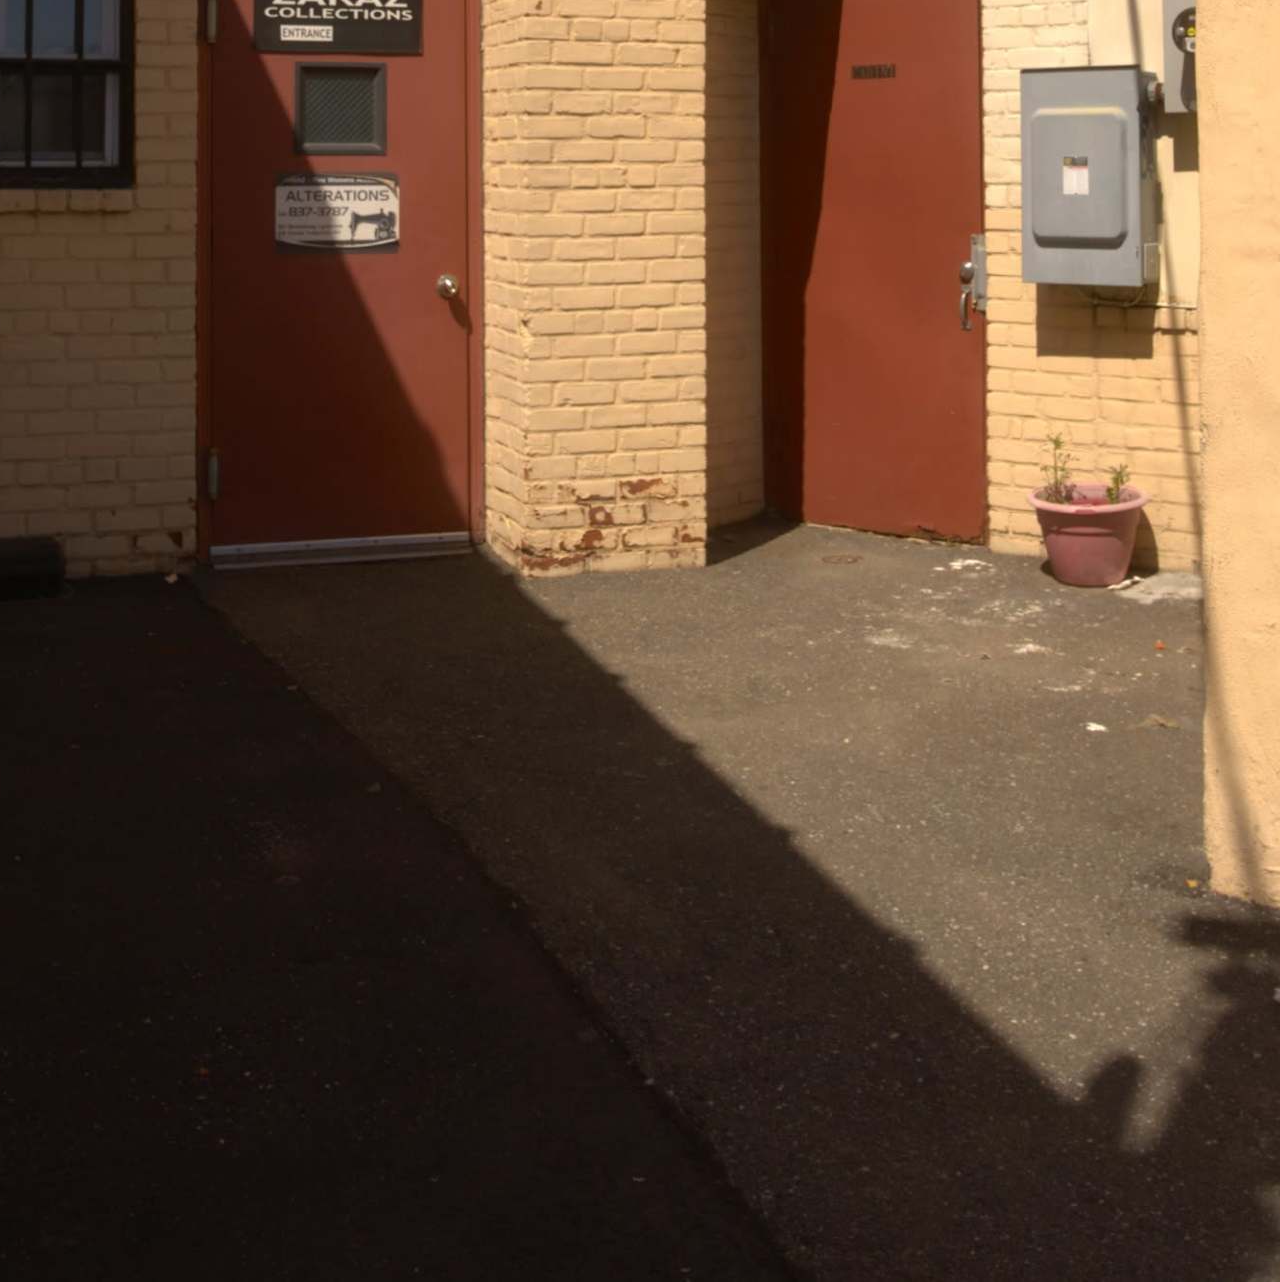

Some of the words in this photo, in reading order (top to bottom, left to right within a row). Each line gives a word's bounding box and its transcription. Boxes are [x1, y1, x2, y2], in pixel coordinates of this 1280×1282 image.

[263, 6, 414, 22] COLLECTIONS
[281, 27, 332, 40] ENTRANCE
[285, 189, 390, 203] ALTERATIONS
